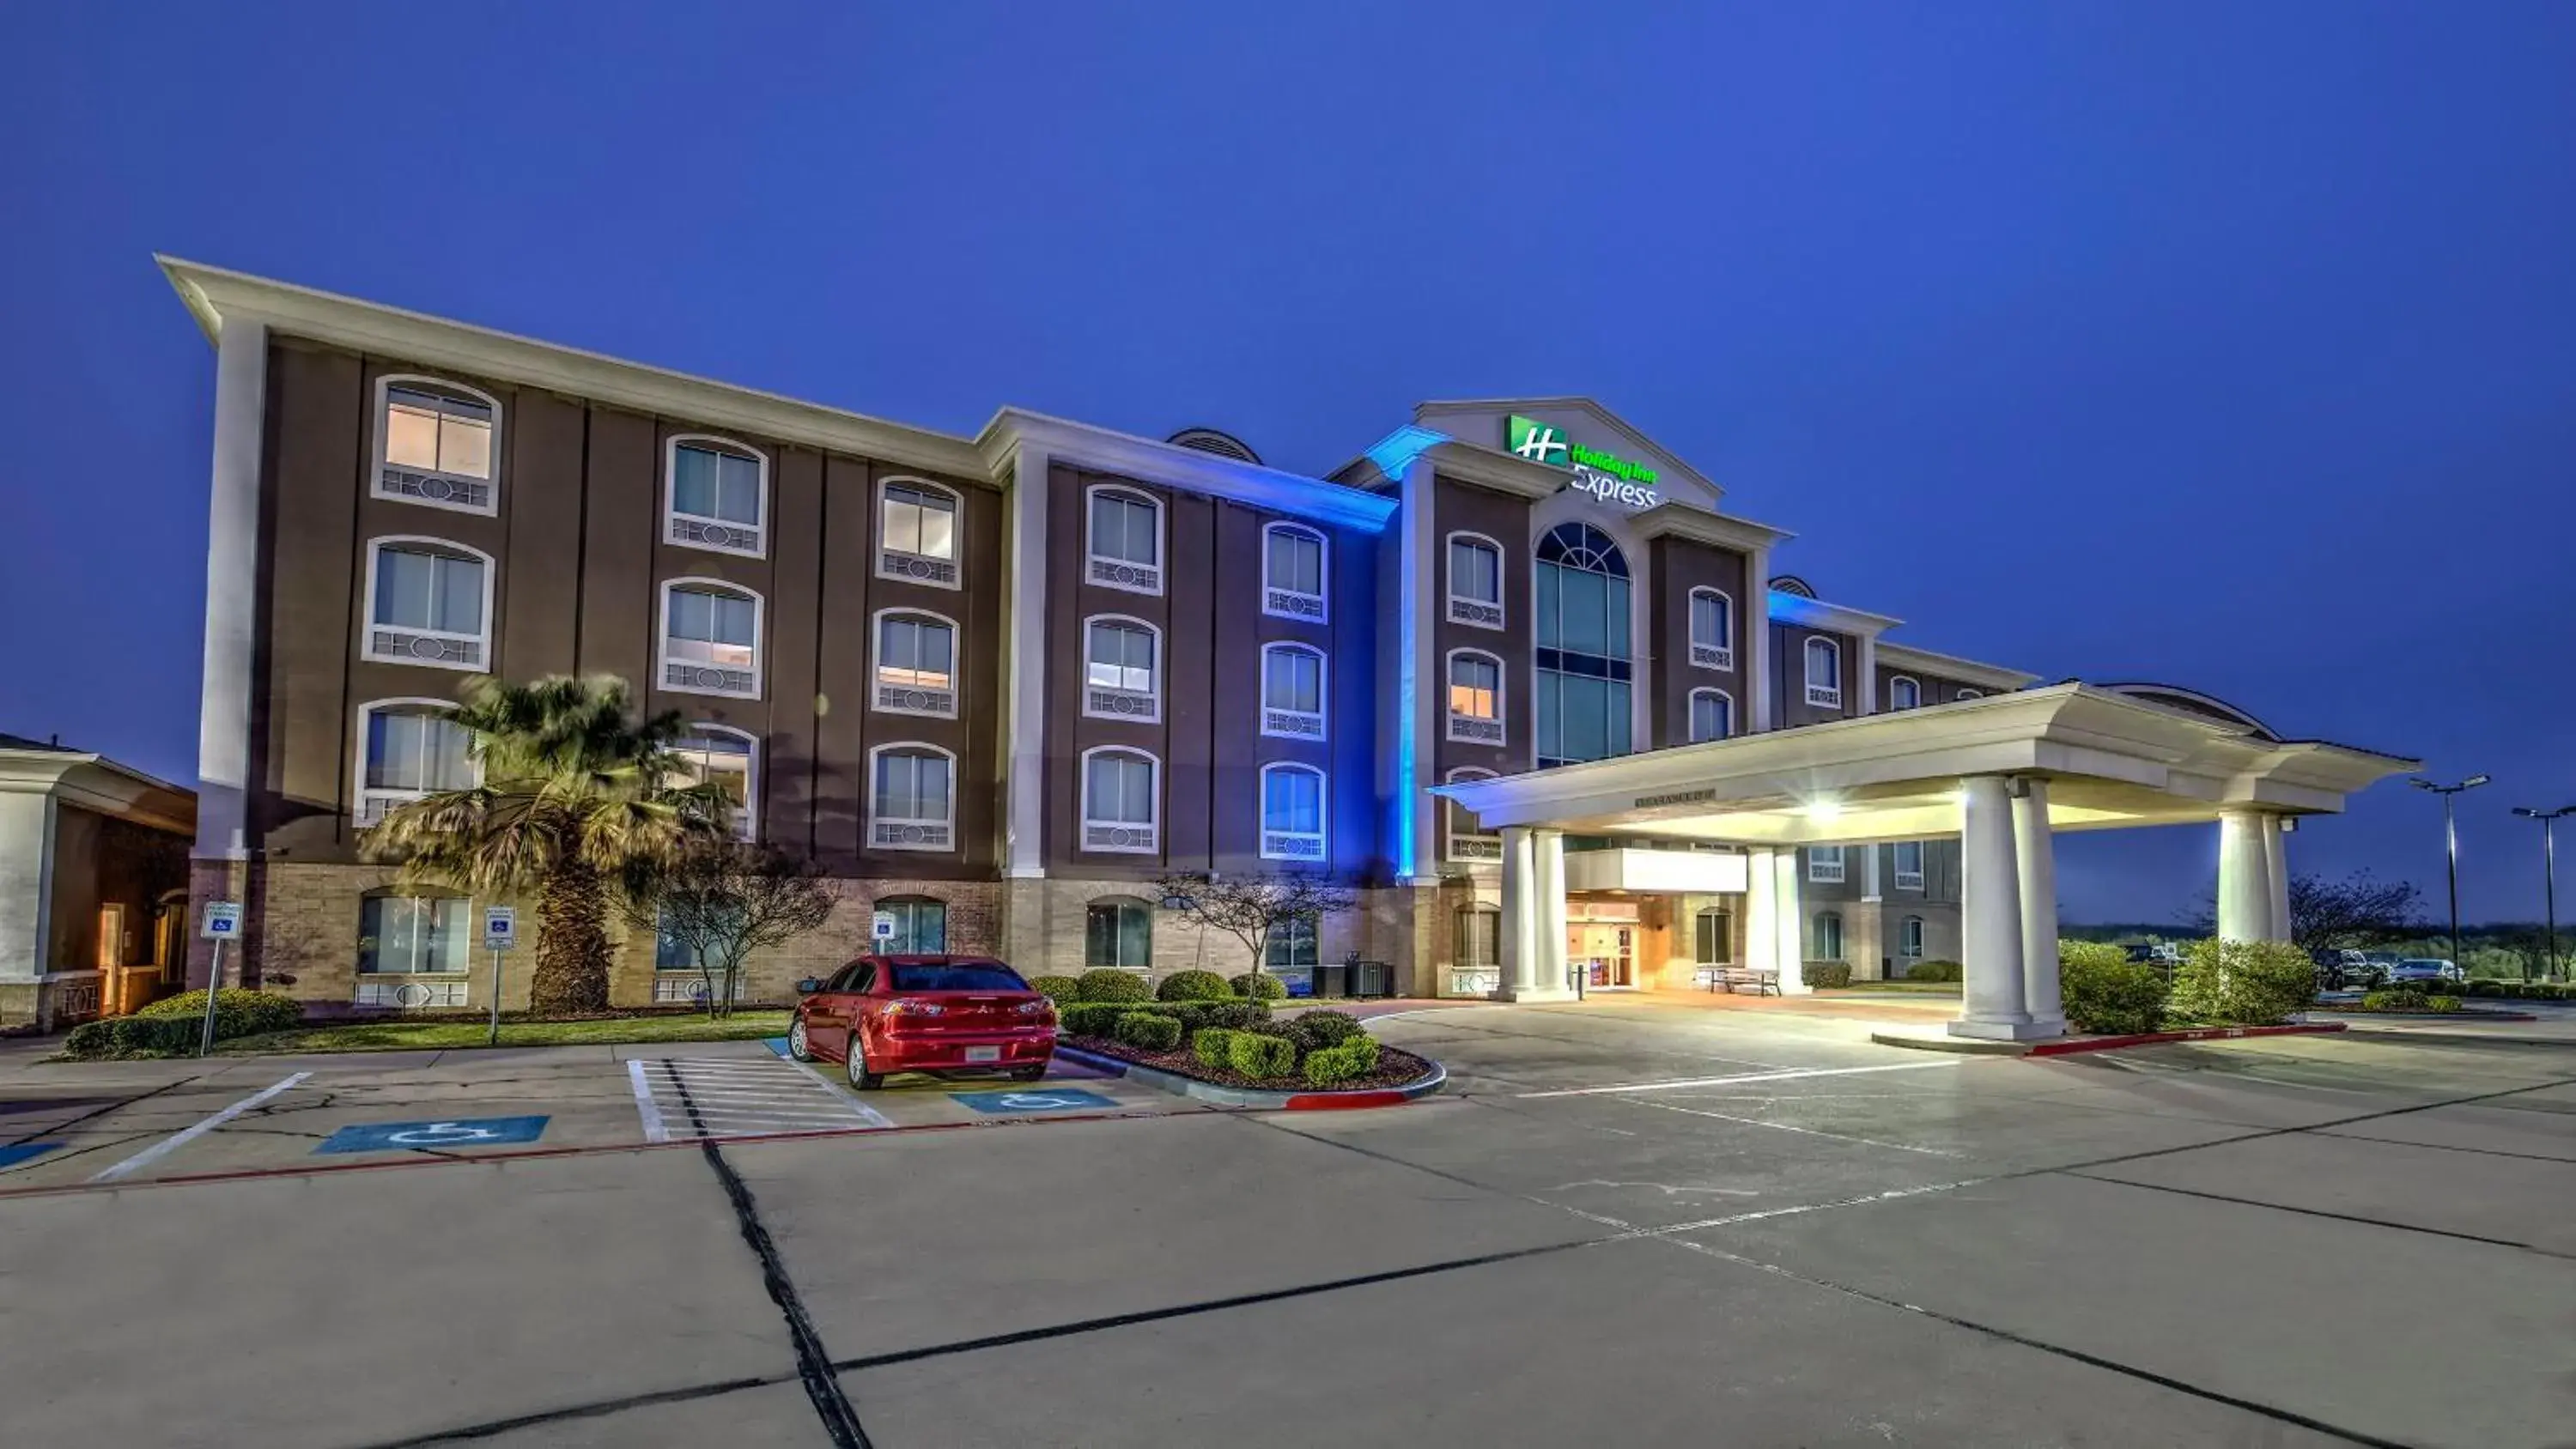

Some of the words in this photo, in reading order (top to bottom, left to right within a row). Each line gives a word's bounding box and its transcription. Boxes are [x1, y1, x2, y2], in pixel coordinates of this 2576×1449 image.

[1571, 443, 1631, 481] Holiday
[1631, 460, 1657, 484] Inn
[1571, 464, 1657, 507] Express
